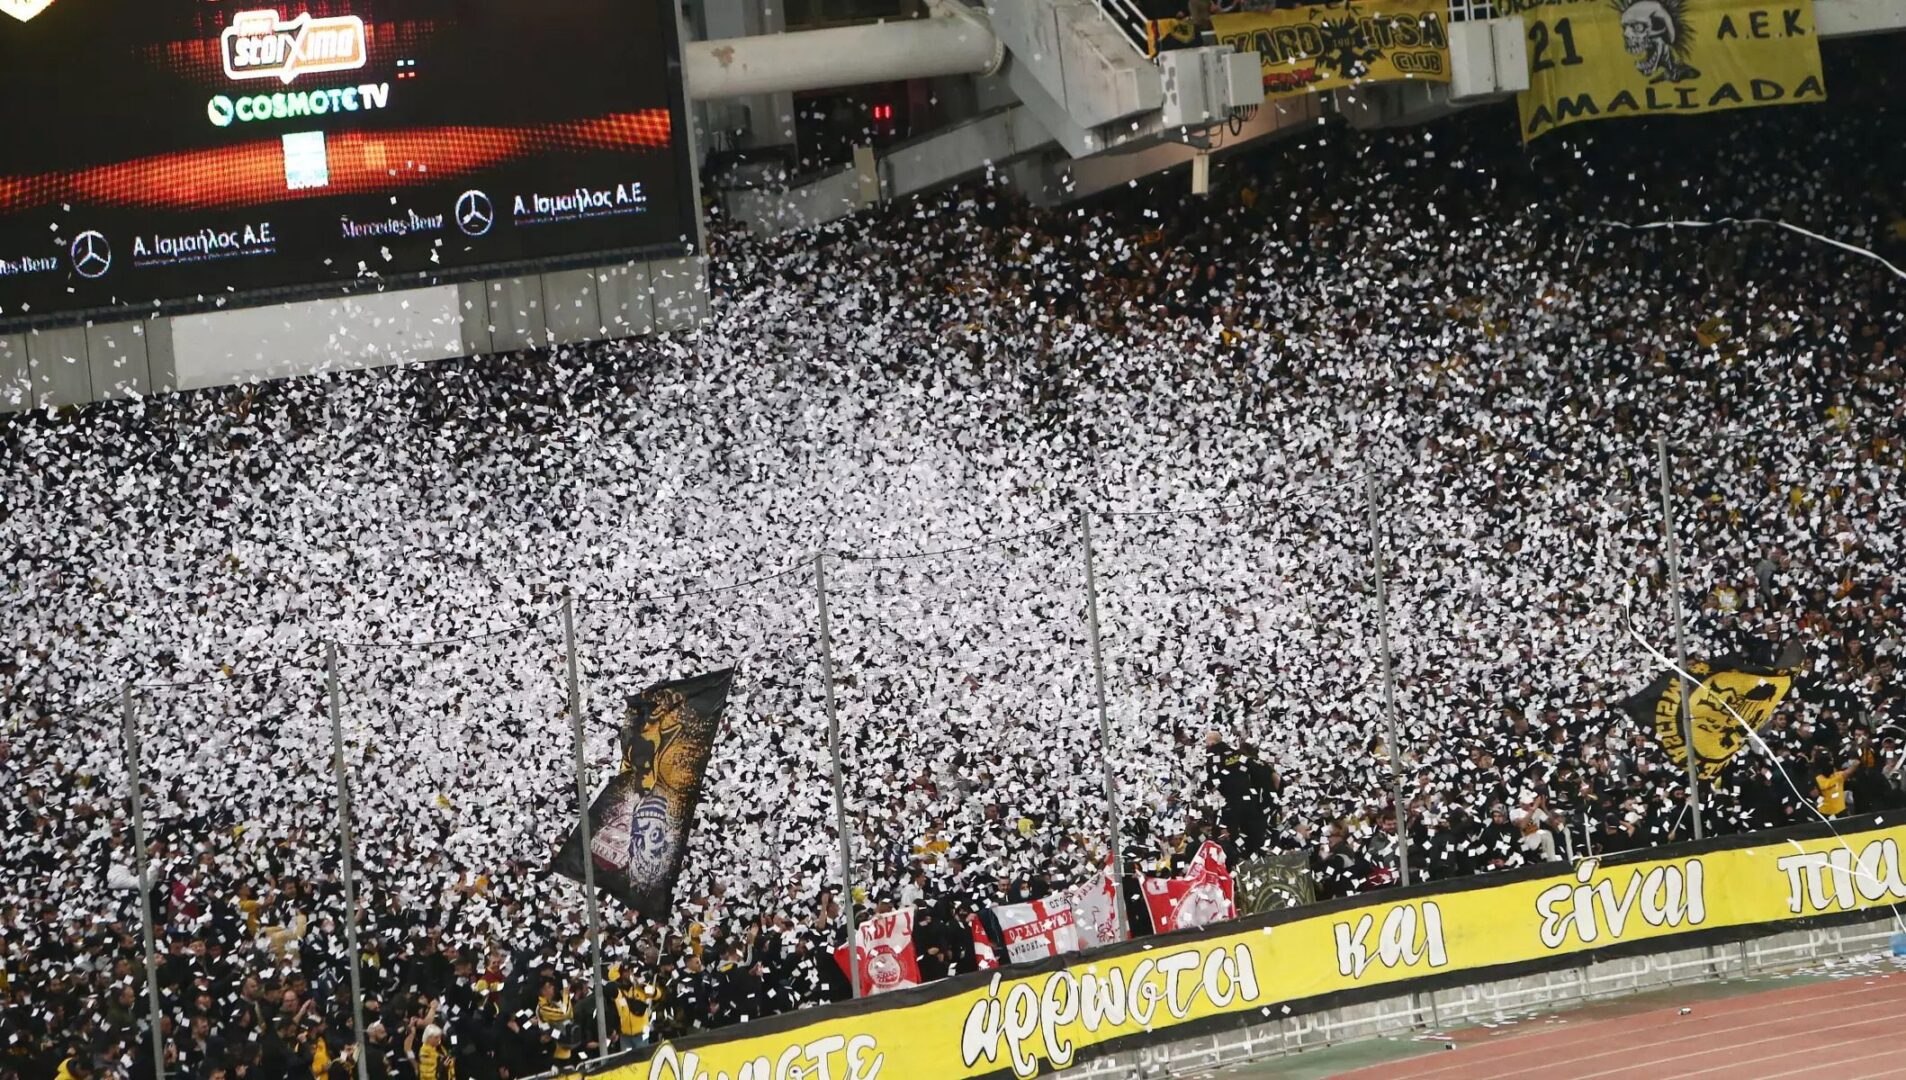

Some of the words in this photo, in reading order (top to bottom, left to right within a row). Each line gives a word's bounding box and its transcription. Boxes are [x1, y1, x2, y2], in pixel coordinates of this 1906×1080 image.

[1358, 11, 1447, 50] ITSA
[1528, 17, 1583, 73] 21
[1393, 51, 1442, 73] CLUB
[357, 82, 389, 110] TV
[1528, 75, 1824, 134] AMALIADA
[342, 213, 443, 238] Mercedes-Benz
[1334, 901, 1449, 980] και
[1537, 858, 1706, 949] είναι
